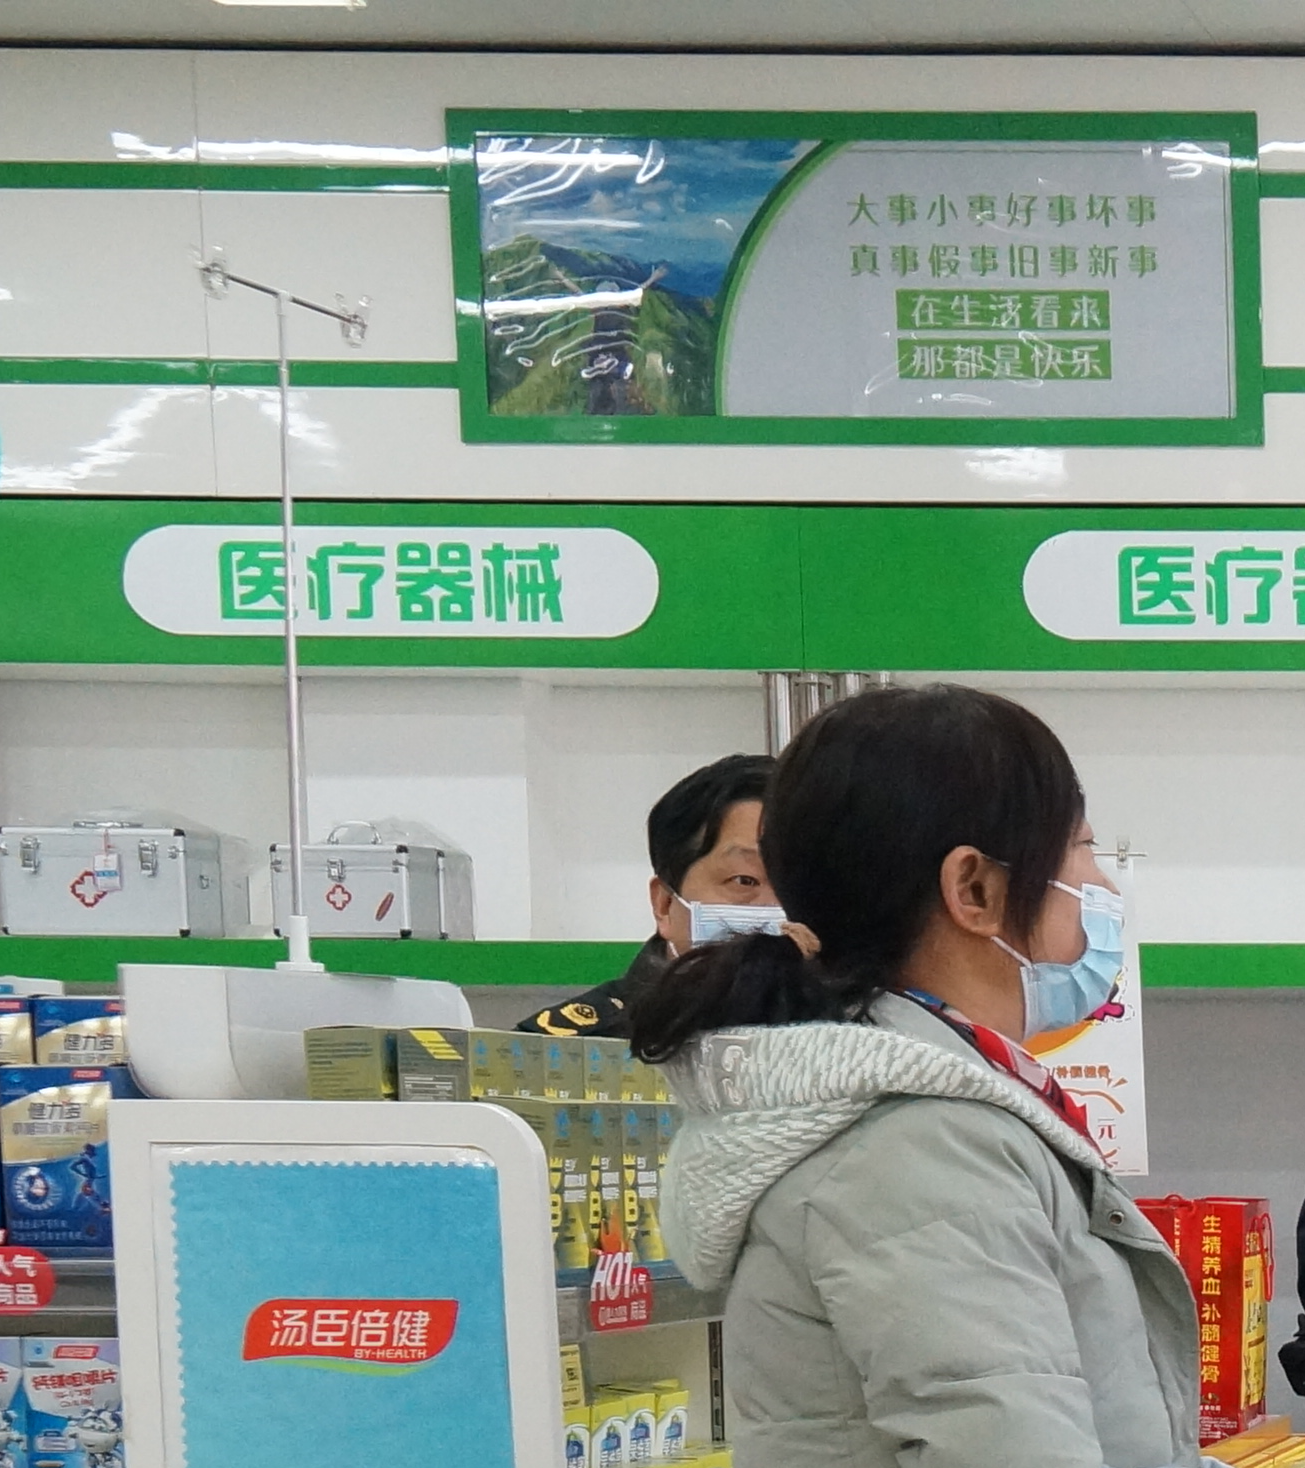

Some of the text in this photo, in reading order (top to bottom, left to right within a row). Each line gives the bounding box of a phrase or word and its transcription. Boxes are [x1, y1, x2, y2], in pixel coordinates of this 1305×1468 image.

[847, 192, 1158, 229] 大事小事好事坏事
[850, 244, 1160, 278] 真事假事旧事新事
[911, 294, 1104, 329] 在生活看来
[911, 342, 1104, 379] 那都是快乐
[217, 540, 565, 623] 医疗器械
[1201, 1214, 1222, 1296] 生精养血
[590, 1251, 633, 1302] HOT
[270, 1309, 431, 1347] 汤臣倍健
[1200, 1303, 1221, 1384] 补髓健骨
[354, 1348, 427, 1359] BY-HEALTH
